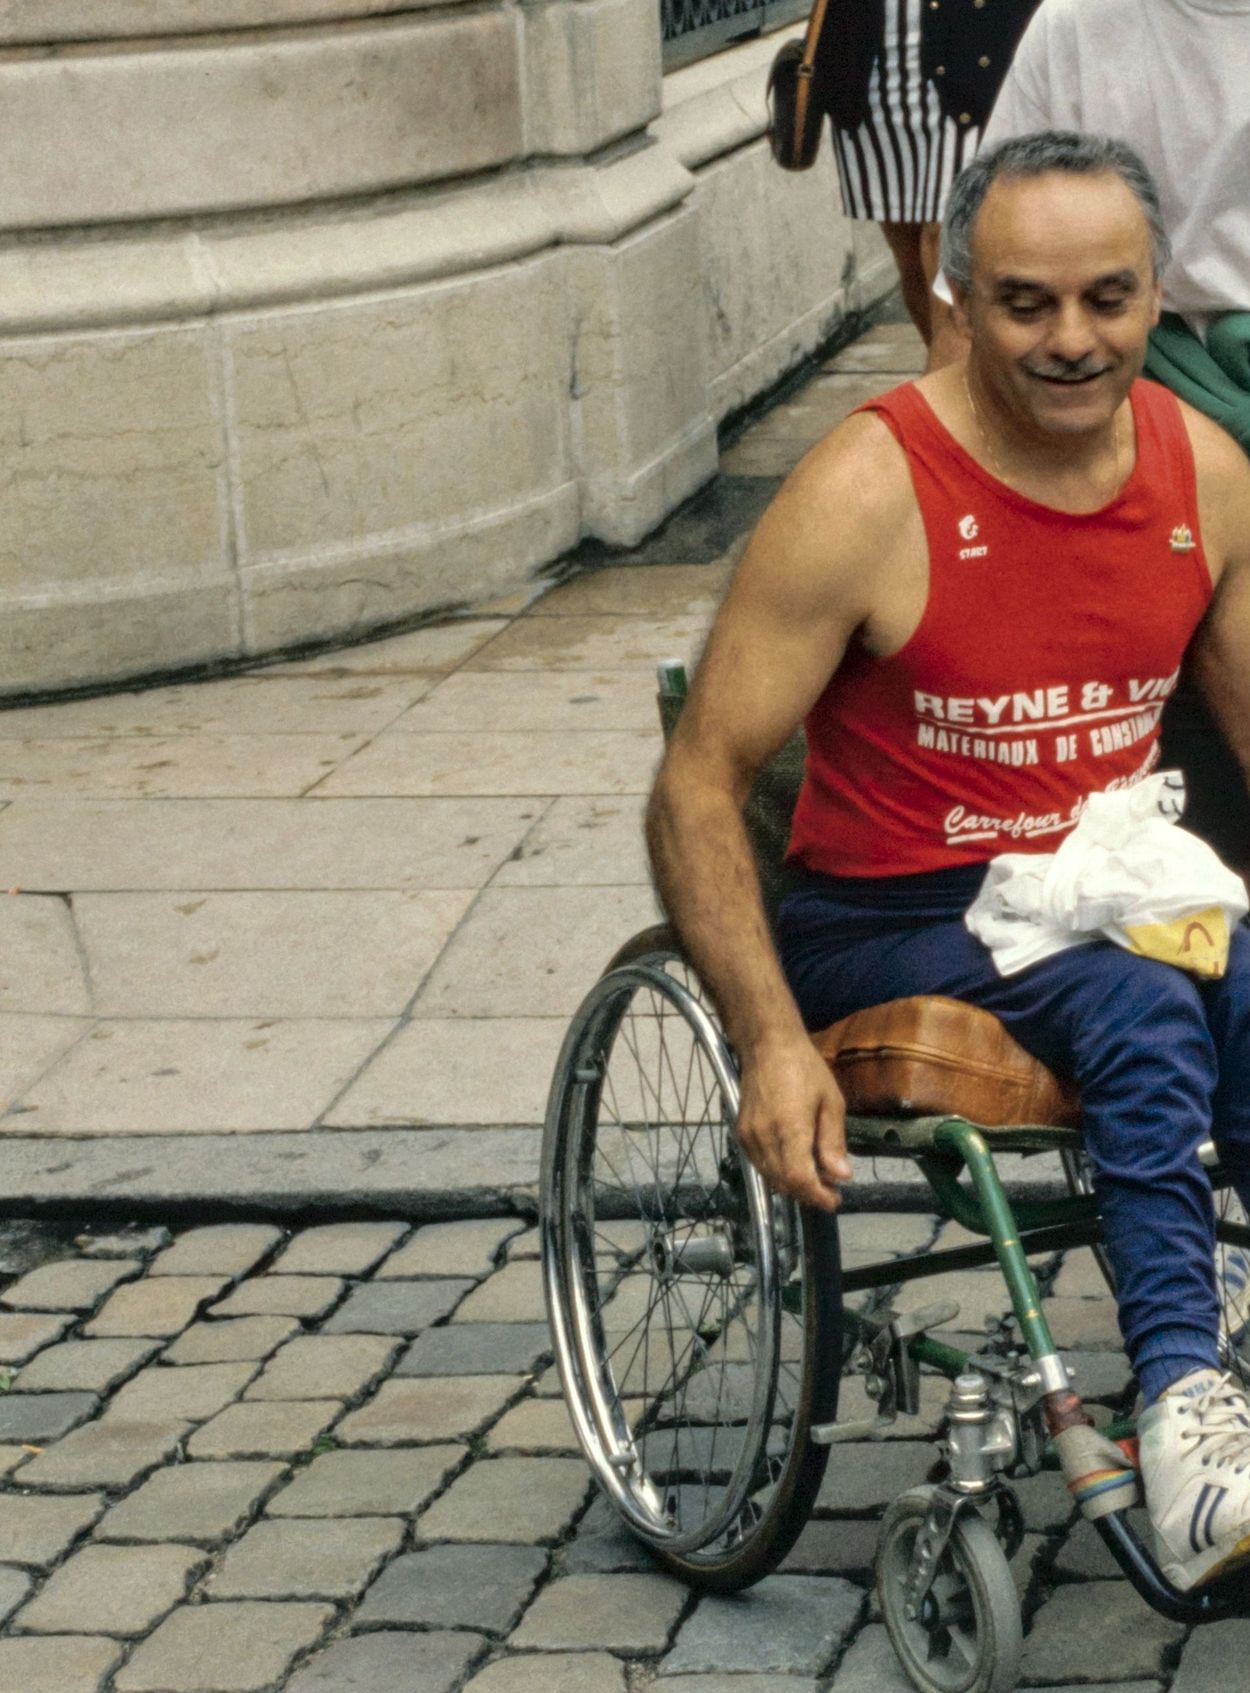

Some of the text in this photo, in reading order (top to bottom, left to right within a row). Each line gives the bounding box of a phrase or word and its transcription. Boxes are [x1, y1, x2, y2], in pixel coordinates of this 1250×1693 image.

[914, 685, 1069, 725] REYNE
[1081, 681, 1114, 711] &
[917, 723, 1039, 767] MATERIAUX
[1056, 734, 1078, 763] DE
[944, 804, 1061, 839] Carrefour
